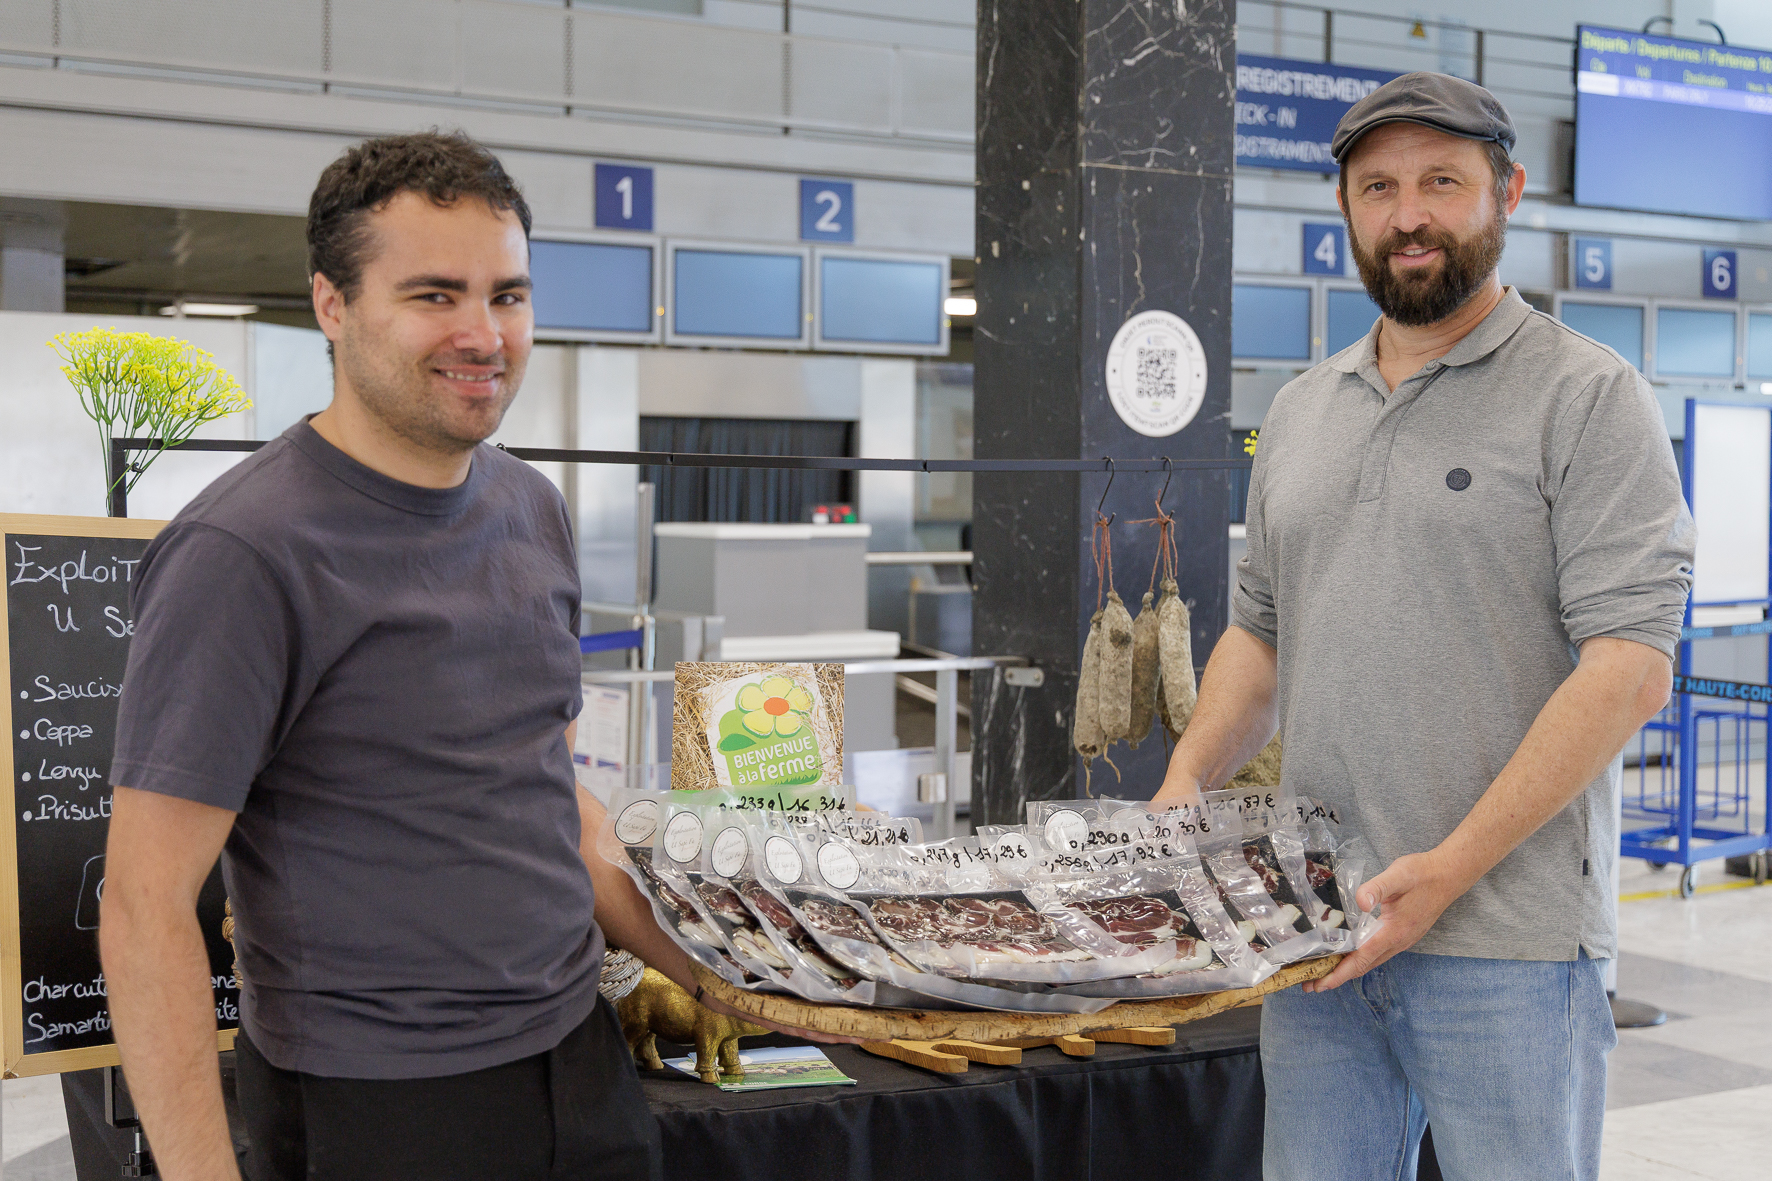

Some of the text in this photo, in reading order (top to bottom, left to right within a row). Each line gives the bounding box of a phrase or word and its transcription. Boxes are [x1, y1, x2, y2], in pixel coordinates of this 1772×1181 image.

[615, 175, 634, 221] 1
[814, 190, 842, 233] 2
[1313, 231, 1337, 270] 4
[1584, 246, 1606, 283] 5
[1711, 256, 1732, 291] 6
[734, 736, 813, 766] BIENVENUE
[738, 754, 816, 784] à la ferme
